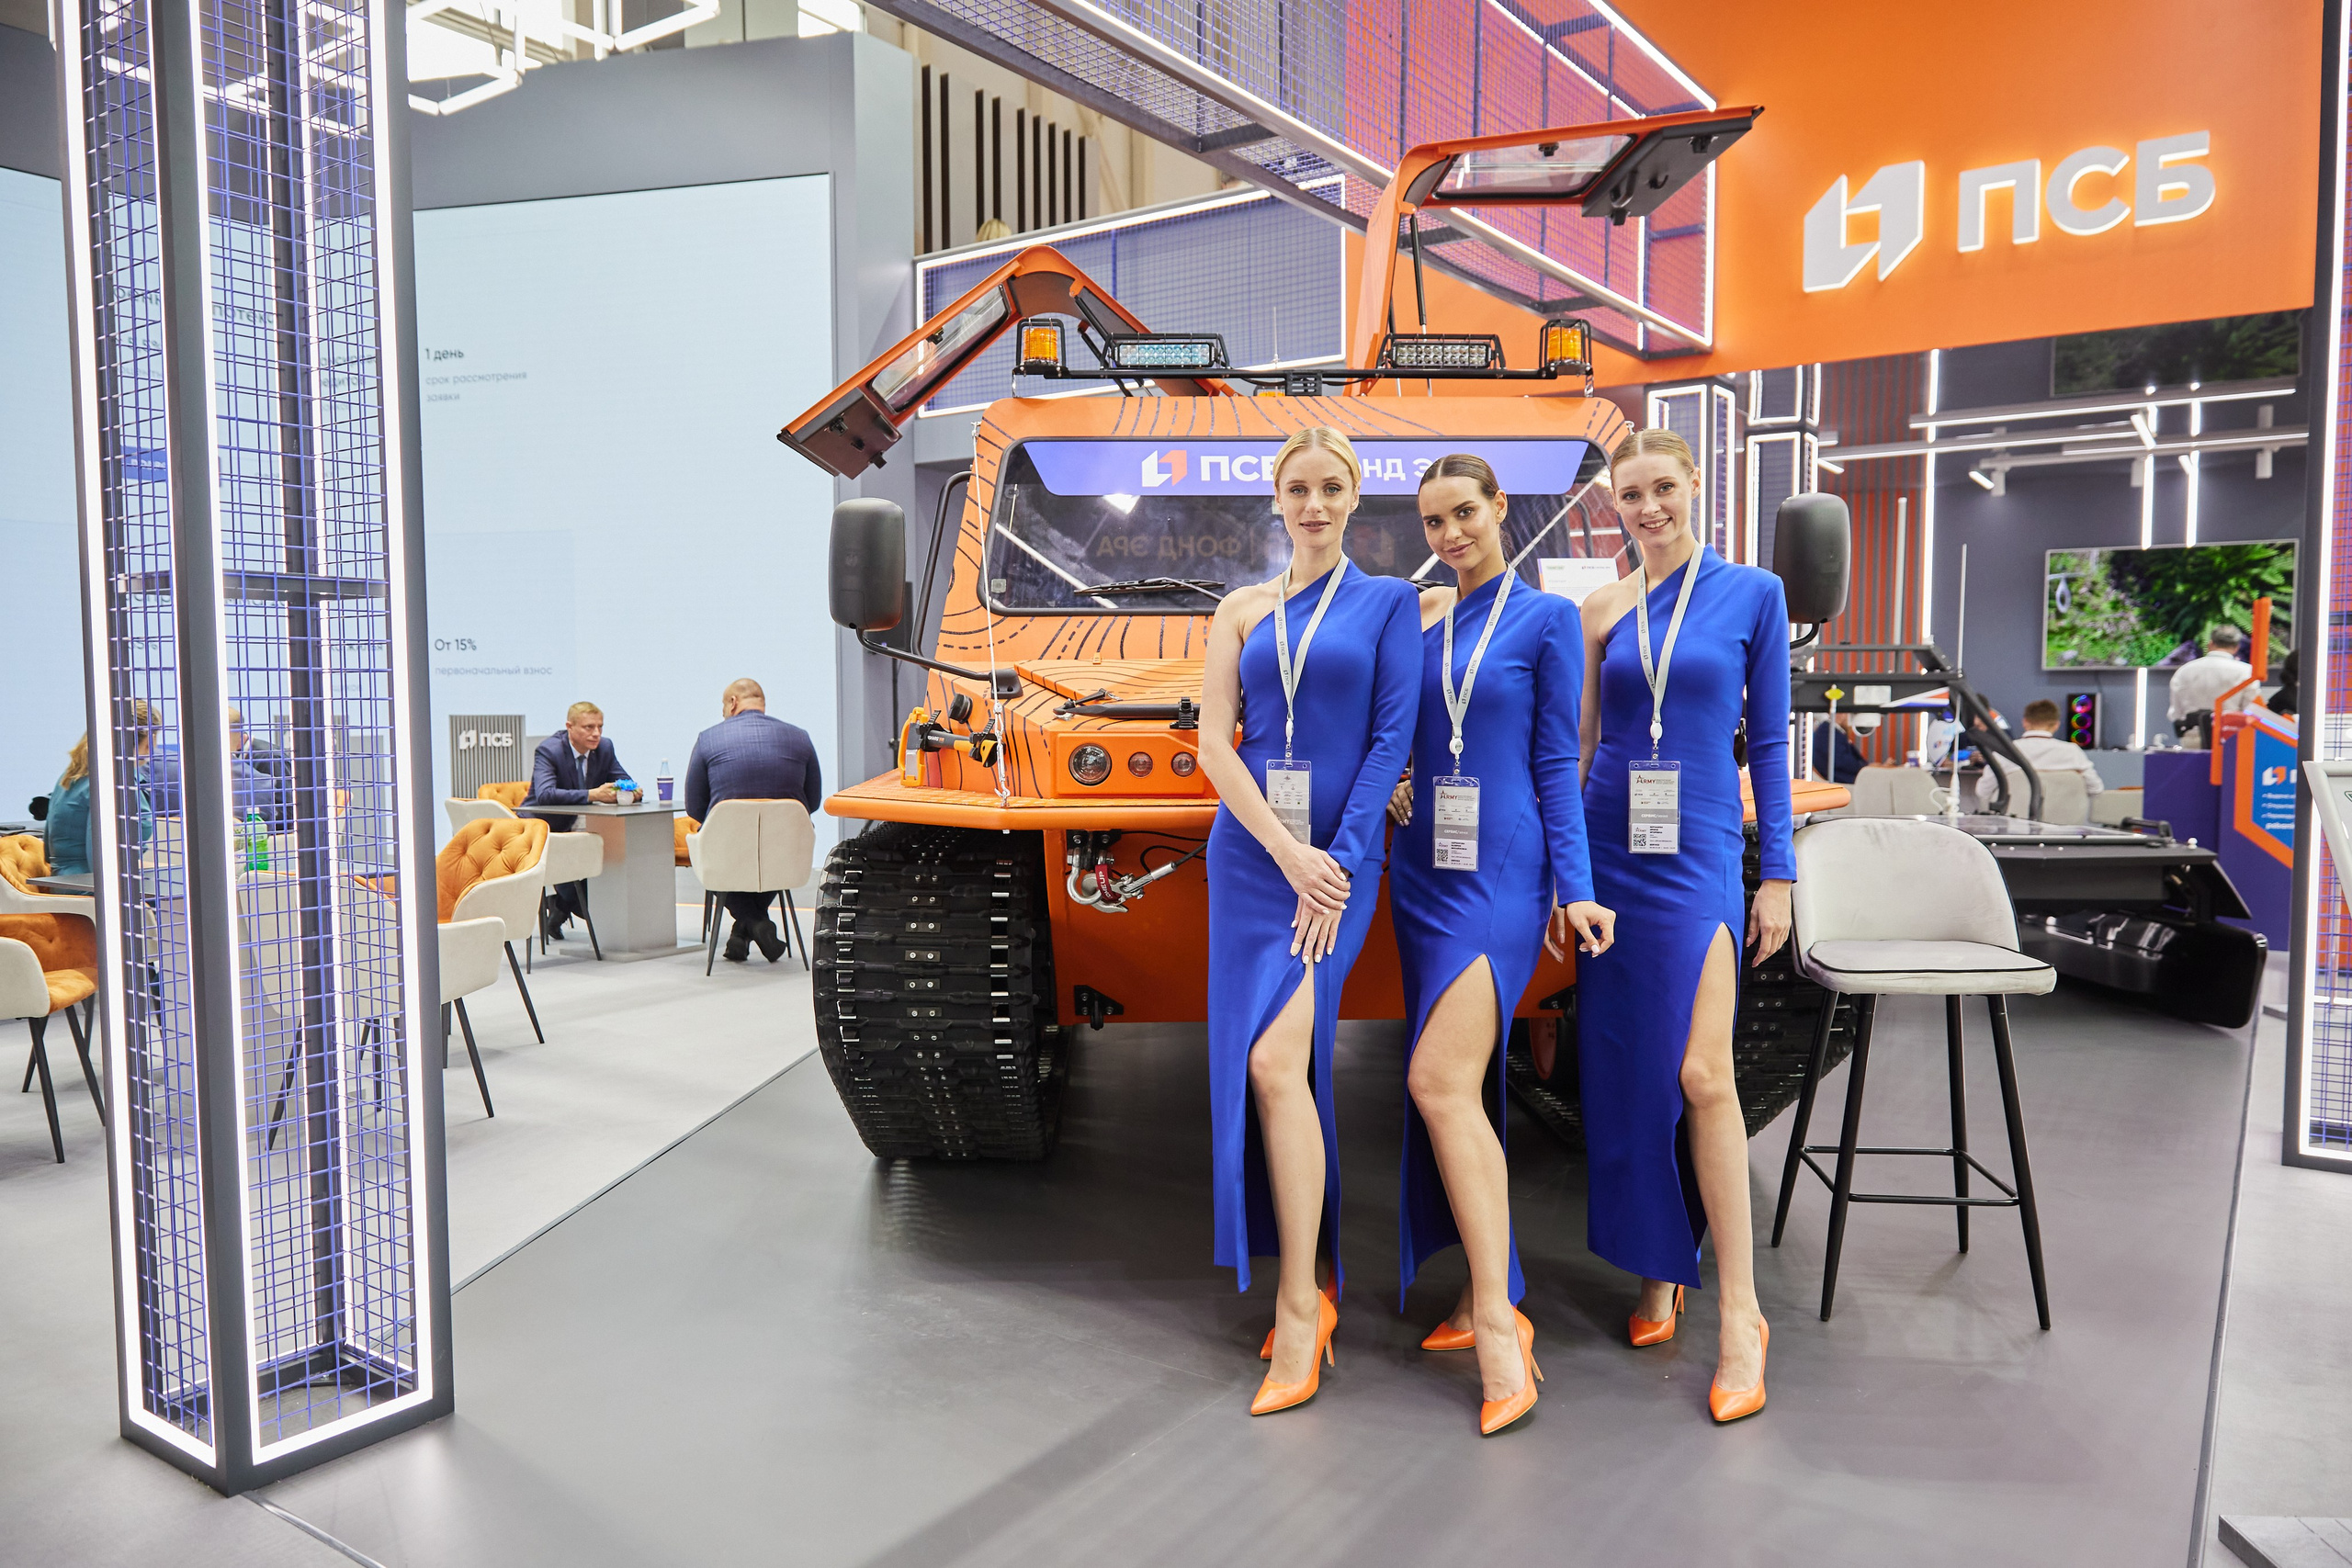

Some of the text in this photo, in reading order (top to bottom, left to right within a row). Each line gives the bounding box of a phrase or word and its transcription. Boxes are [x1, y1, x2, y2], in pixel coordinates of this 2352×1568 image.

[1958, 130, 2216, 253] ПСБ
[425, 348, 464, 361] 1 день
[425, 371, 527, 386] срок рассмотрения
[435, 638, 477, 651] От 15%
[435, 666, 552, 677] первоначальный взнос
[480, 732, 514, 748] ПСБ
[1636, 775, 1657, 784] ARMY
[1439, 790, 1458, 800] ARMY
